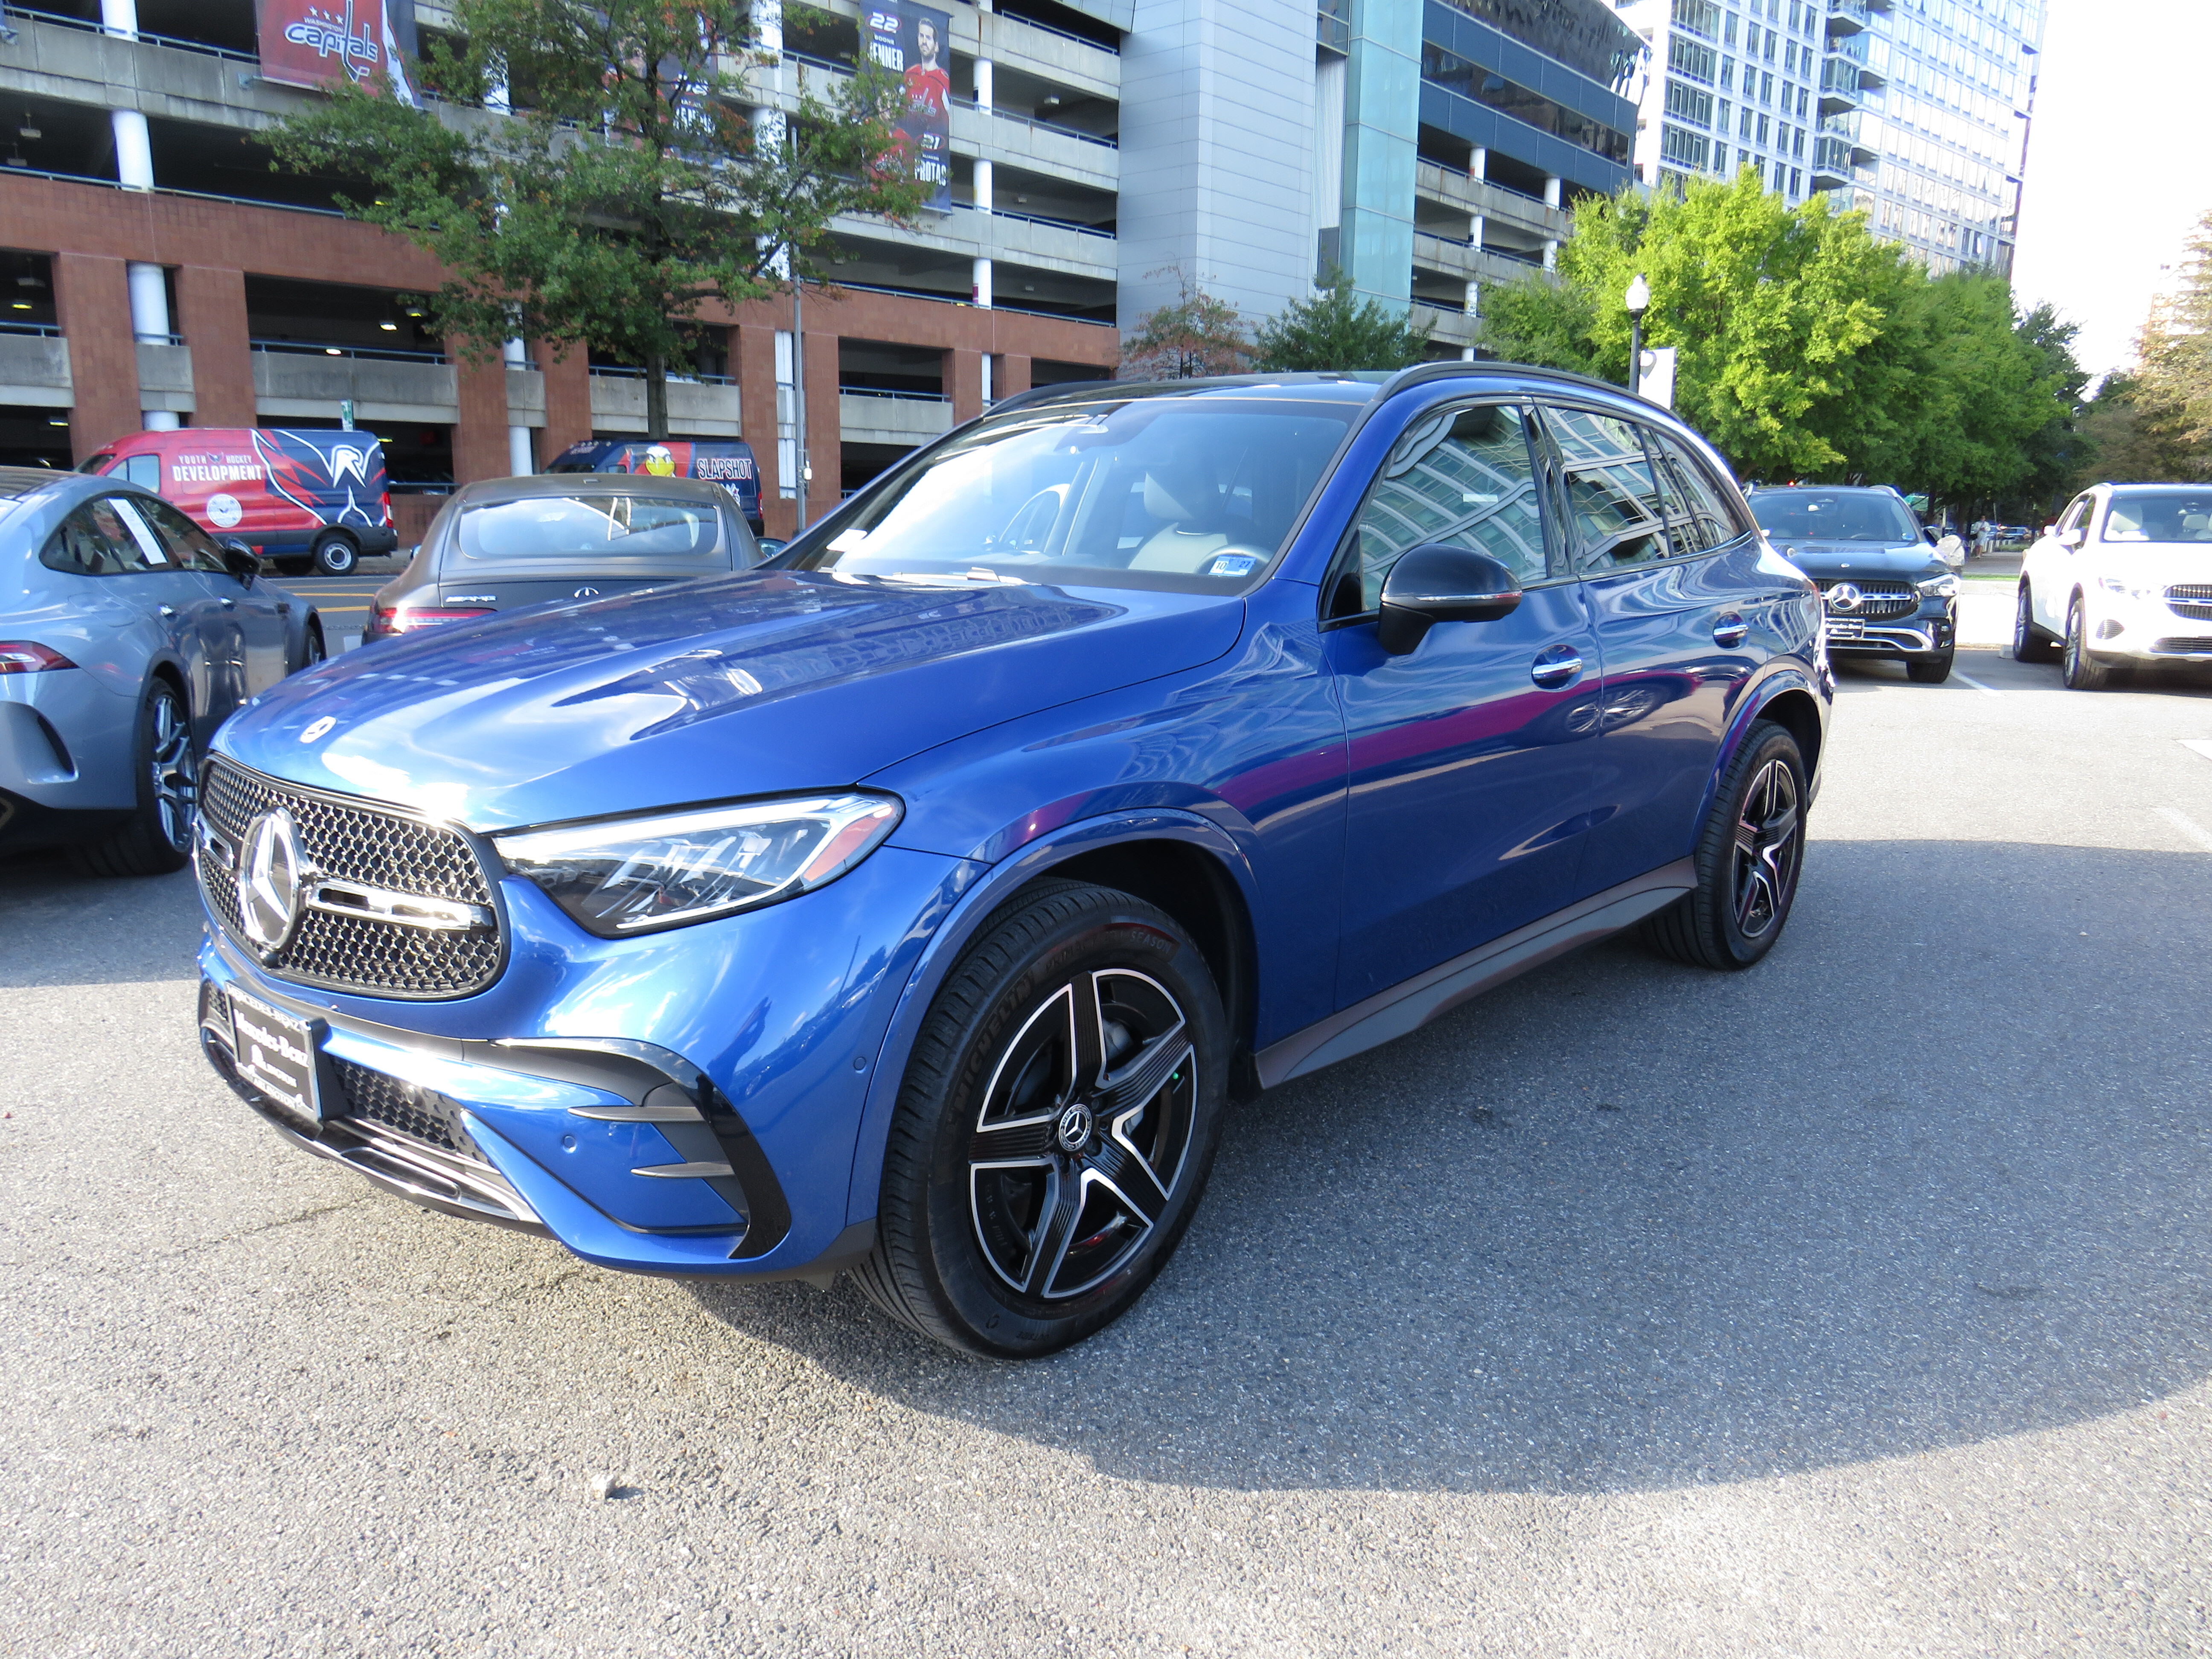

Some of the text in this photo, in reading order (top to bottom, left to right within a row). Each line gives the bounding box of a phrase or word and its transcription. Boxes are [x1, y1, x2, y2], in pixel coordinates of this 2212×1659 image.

[870, 12, 898, 33] 22
[874, 34, 895, 45] BOONE
[914, 158, 946, 186] PROTAS
[178, 455, 252, 464] YOUTH HOCKEY
[697, 458, 752, 480] SLAPSHOT
[172, 465, 262, 482] DEVELOPMENT
[1215, 561, 1227, 570] 10
[1131, 930, 1173, 955] SEASON
[954, 976, 1033, 1112] MICHELIN
